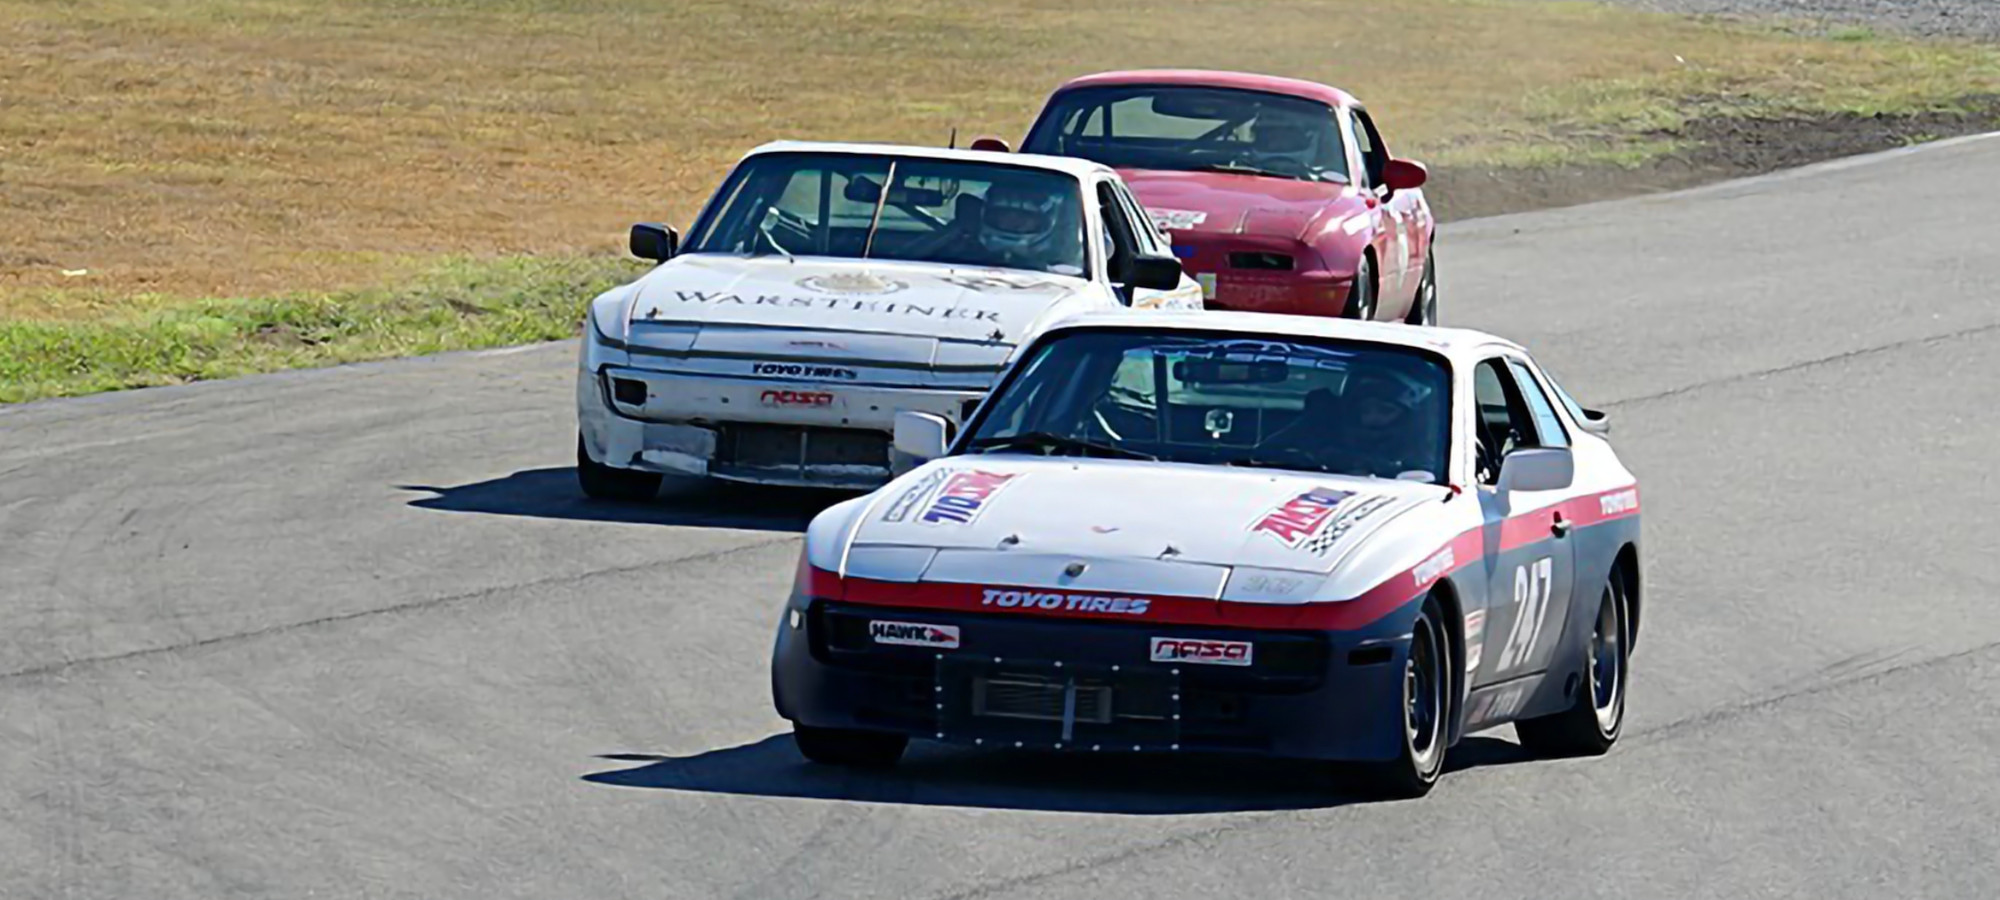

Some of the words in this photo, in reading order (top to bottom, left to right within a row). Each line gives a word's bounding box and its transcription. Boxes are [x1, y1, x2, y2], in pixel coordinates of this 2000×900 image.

[753, 363, 802, 375] TOYO
[982, 589, 1063, 609] TOYO
[1065, 594, 1151, 614] TIRES
[1496, 557, 1552, 672] 247
[872, 623, 928, 641] HAWK
